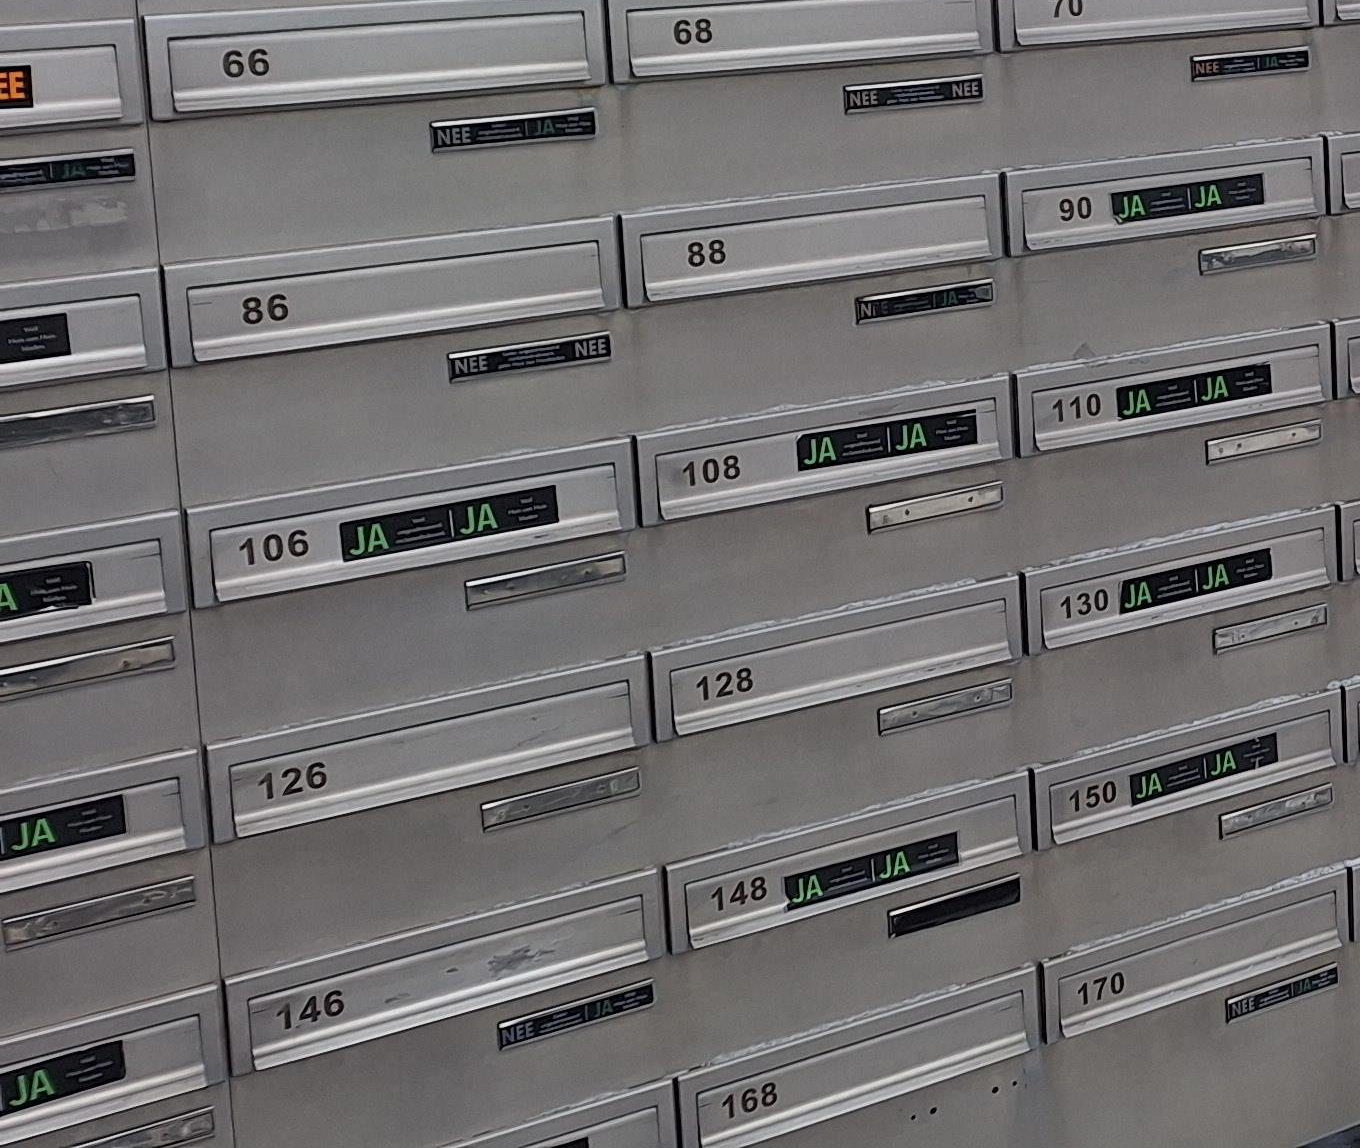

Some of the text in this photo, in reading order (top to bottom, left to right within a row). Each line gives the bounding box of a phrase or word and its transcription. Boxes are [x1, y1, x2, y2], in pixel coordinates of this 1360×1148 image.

[673, 18, 713, 45] 68
[222, 48, 270, 78] 66
[1195, 61, 1221, 75] NEE
[0, 70, 26, 101] EE
[850, 90, 879, 107] NEE
[952, 81, 980, 98] NEE
[437, 127, 472, 146] NEE
[1058, 196, 1093, 222] 90
[1118, 184, 1222, 219] JA JA
[687, 239, 727, 268] 88
[242, 293, 290, 325] 86
[454, 355, 489, 375] NEE
[574, 338, 607, 358] NEE
[1051, 393, 1102, 423] 110
[1122, 389, 1152, 415] JA
[1201, 375, 1229, 401] JA
[804, 436, 837, 465] JA
[895, 422, 928, 451] JA
[682, 455, 742, 487] 108
[350, 522, 390, 556] JA
[460, 503, 499, 536] JA
[239, 529, 310, 566] 106
[1124, 581, 1153, 609] JA
[1202, 563, 1230, 590] JA
[1060, 588, 1110, 620] 130
[696, 667, 754, 702] 128
[257, 761, 328, 800] 126
[1135, 750, 1237, 800] JA JA
[1069, 780, 1118, 813] 150
[11, 817, 57, 851] JA
[792, 851, 911, 902] JA JA
[711, 876, 768, 912] 148
[1077, 971, 1126, 1006] 170
[276, 989, 346, 1030] 146
[1231, 999, 1256, 1018] NEE
[501, 1022, 536, 1046] NEE
[9, 1068, 57, 1107] JA
[722, 1082, 779, 1120] 168
